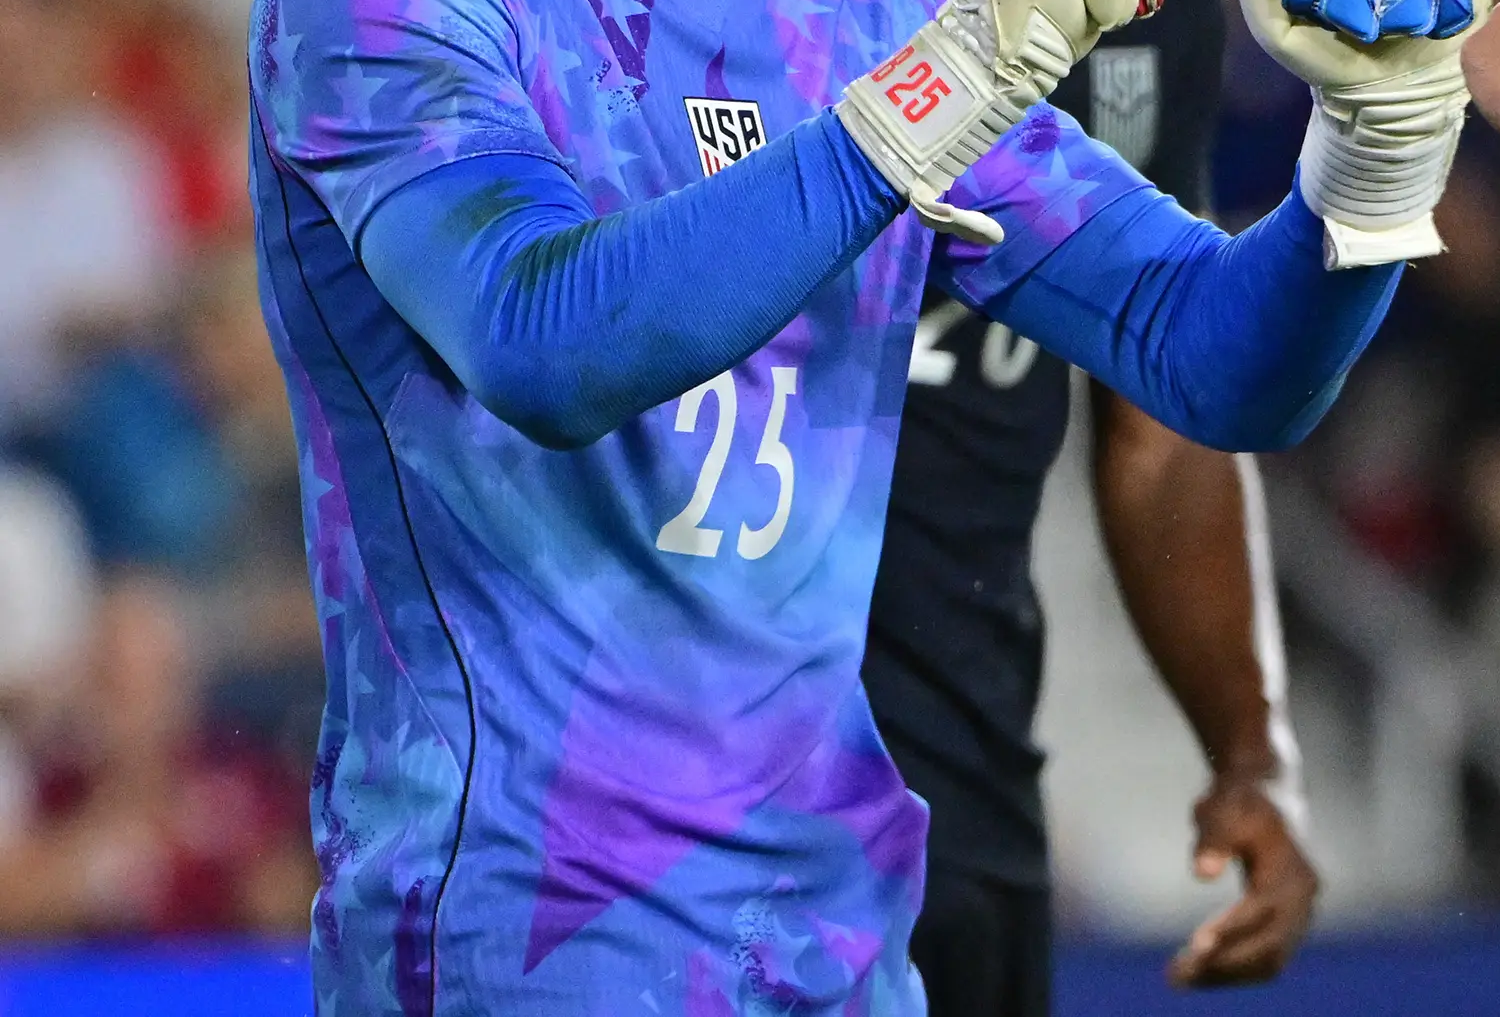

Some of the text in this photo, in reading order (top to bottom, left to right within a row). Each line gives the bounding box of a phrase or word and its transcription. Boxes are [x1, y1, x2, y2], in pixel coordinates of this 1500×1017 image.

[884, 60, 952, 124] 25
[692, 106, 762, 162] USA
[655, 366, 798, 561] 25
